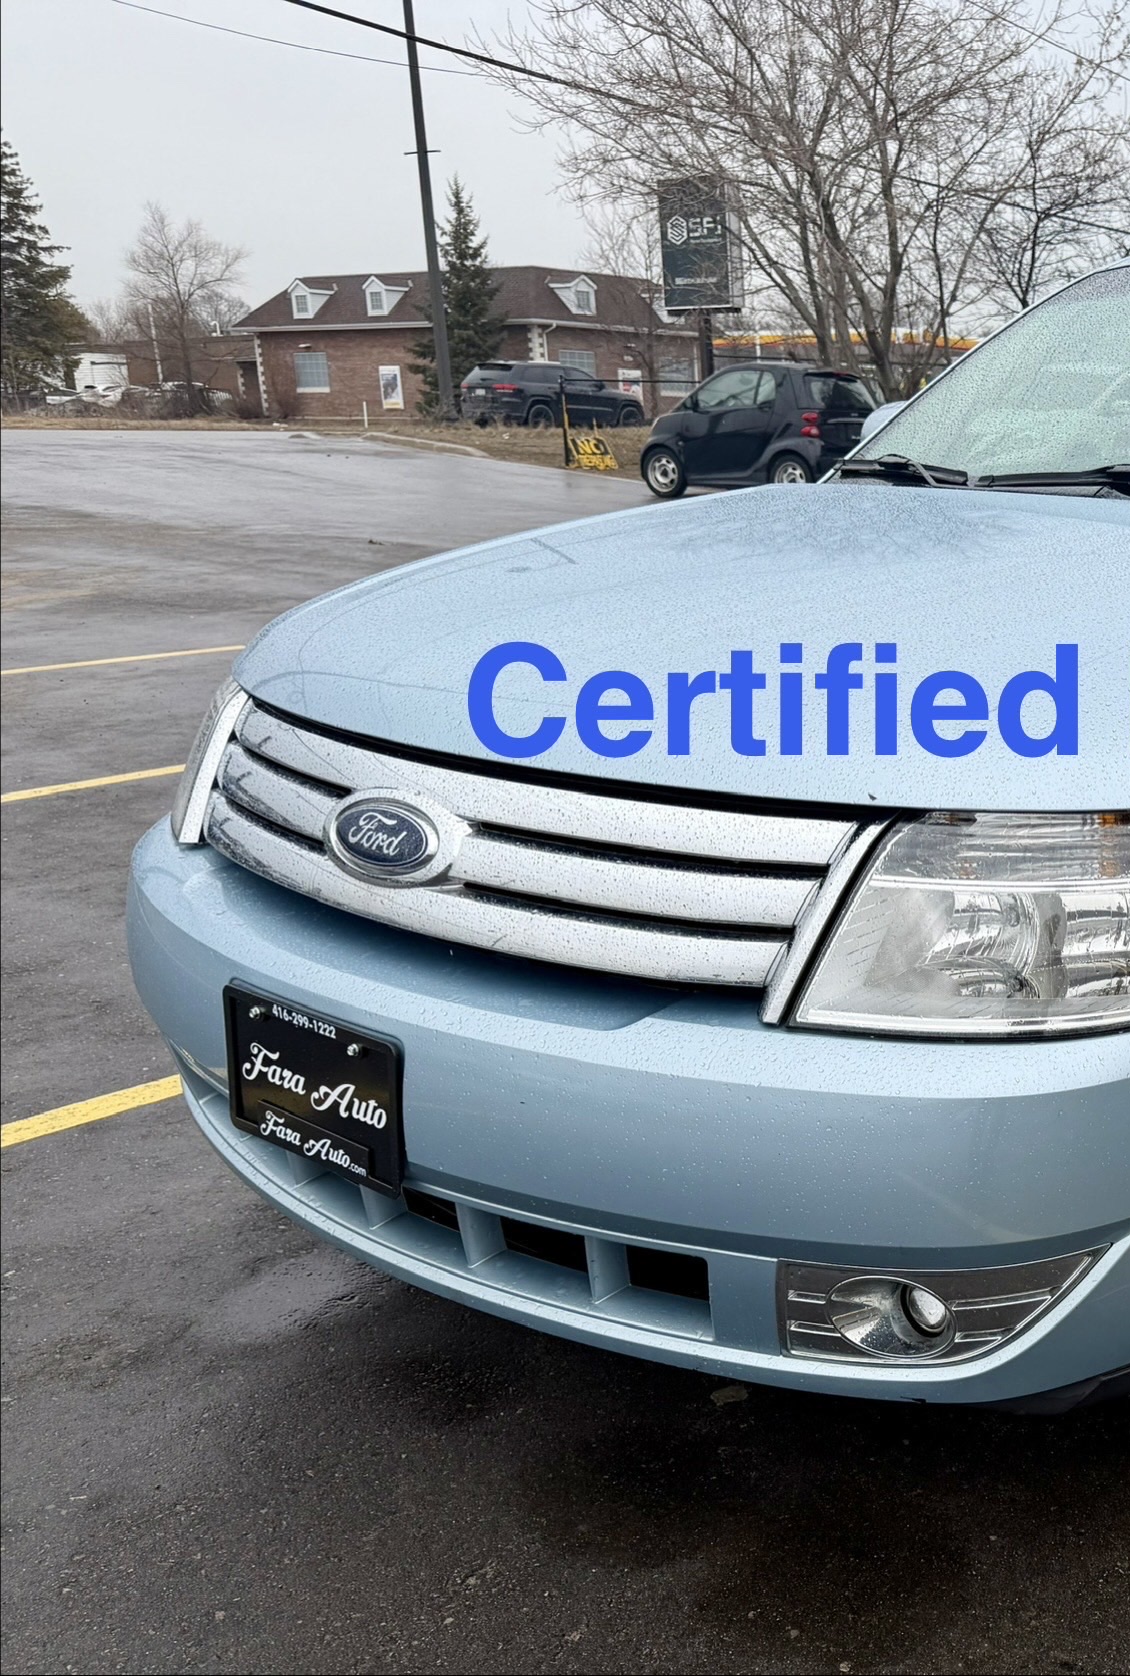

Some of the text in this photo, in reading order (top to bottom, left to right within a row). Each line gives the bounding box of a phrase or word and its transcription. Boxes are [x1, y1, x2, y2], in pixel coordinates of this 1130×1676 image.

[576, 439, 606, 455] NO
[348, 811, 407, 856] Ford
[272, 1003, 337, 1039] 416-299-1222
[242, 1042, 387, 1129] Fara Auto
[260, 1110, 302, 1146] Fara
